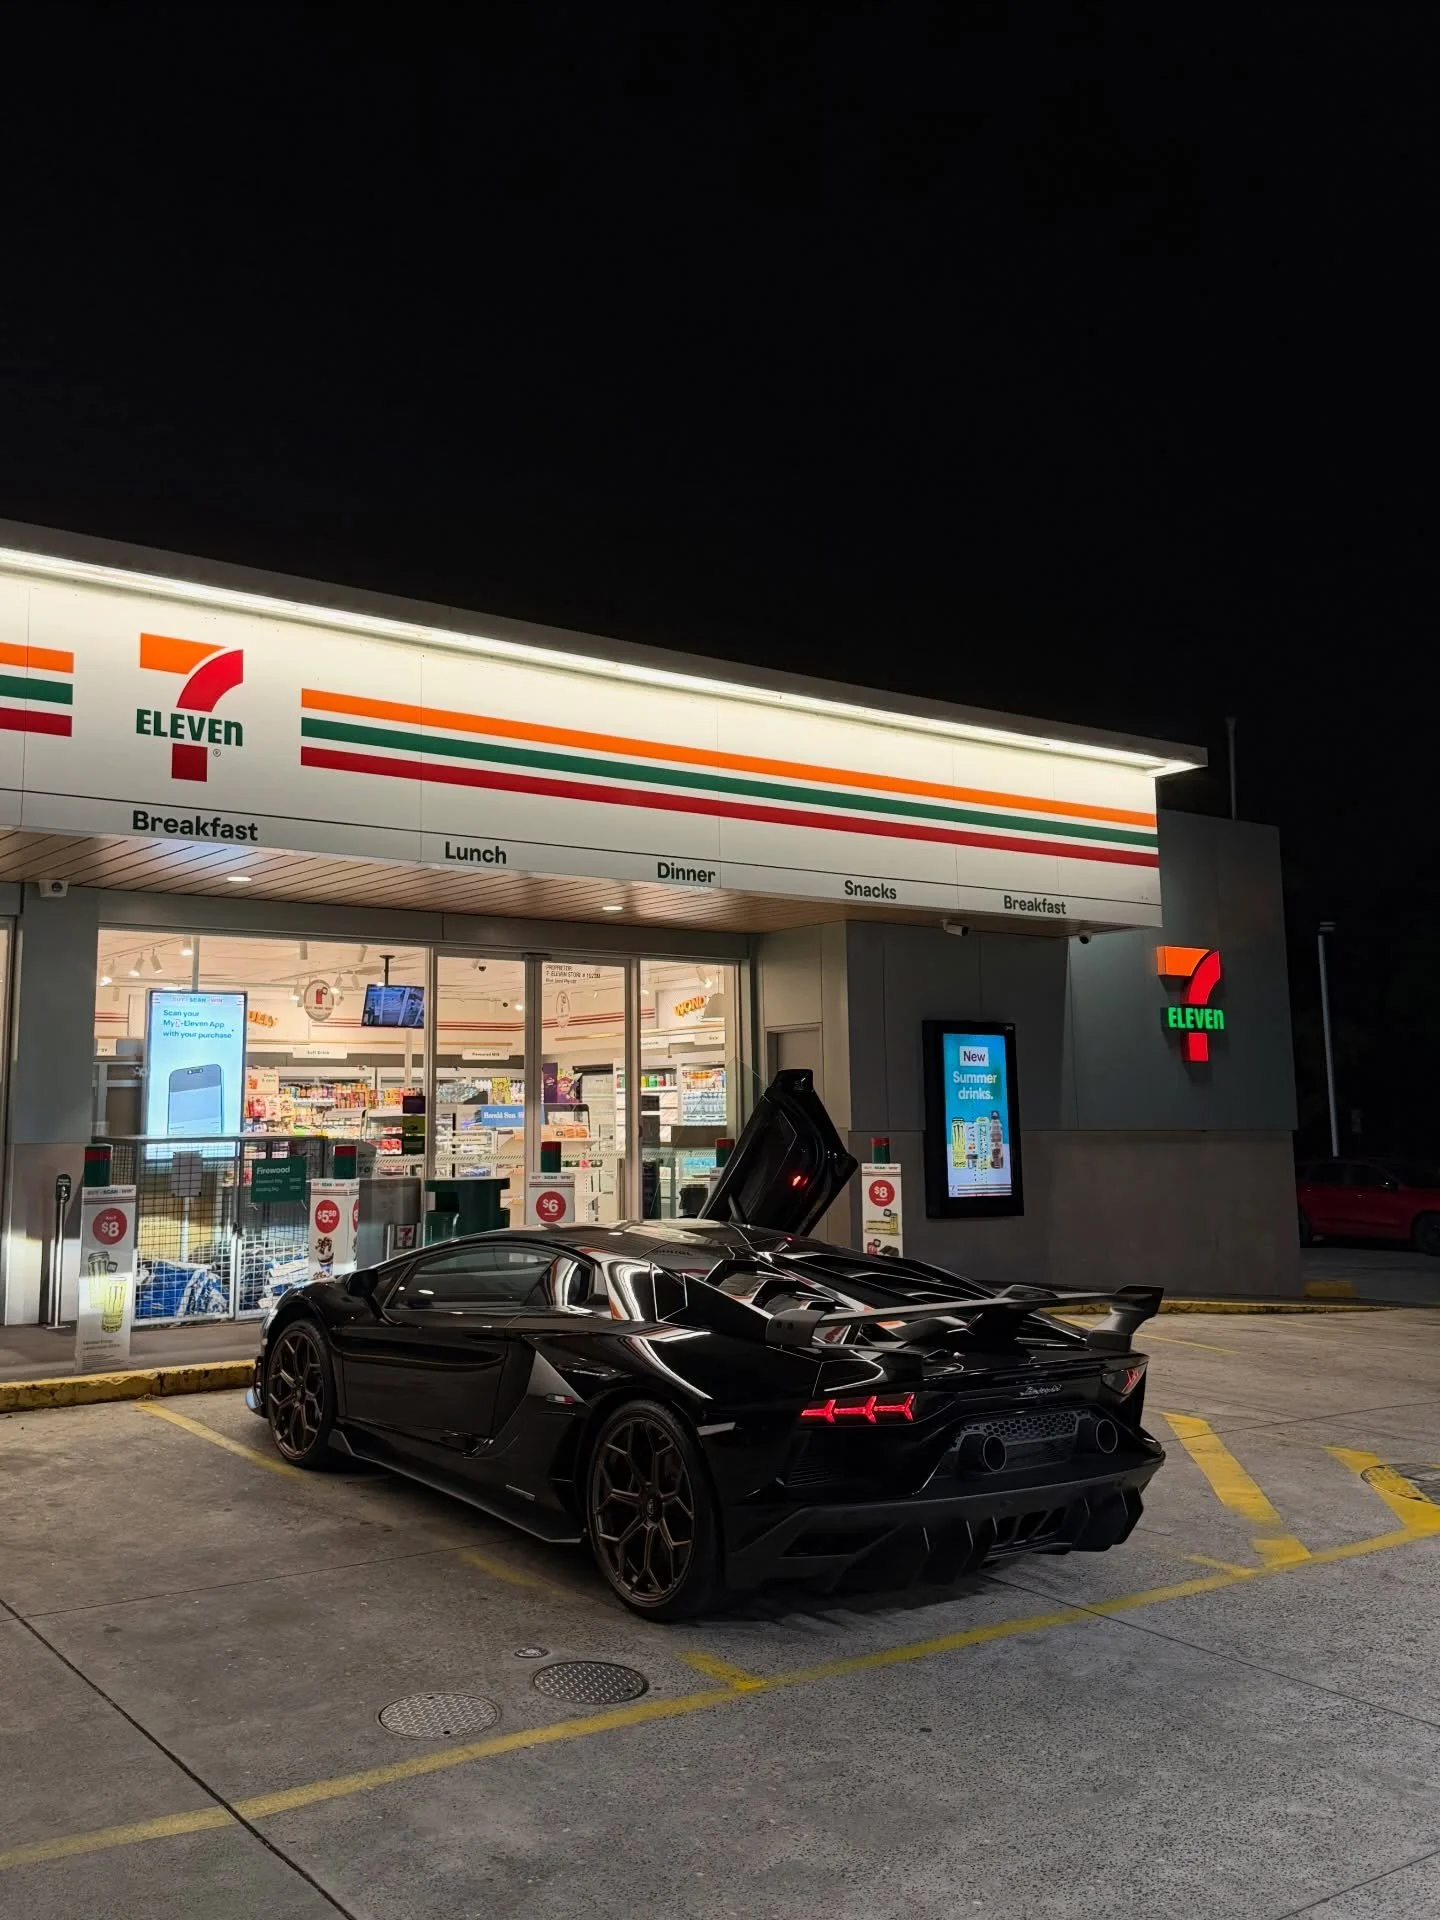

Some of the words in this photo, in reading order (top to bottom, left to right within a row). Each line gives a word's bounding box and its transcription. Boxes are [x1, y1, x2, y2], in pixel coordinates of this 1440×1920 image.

[139, 632, 244, 783] 7
[132, 809, 259, 841] Breakfast
[444, 841, 507, 865] Lunch
[657, 862, 716, 883] Dinner
[844, 879, 898, 900] Snacks
[1003, 895, 1067, 915] Breakfast
[1155, 945, 1221, 1062] 7
[163, 1009, 182, 1017] Scan
[163, 1019, 175, 1028] My
[209, 1021, 225, 1029] App
[963, 1050, 986, 1062] New
[952, 1071, 998, 1084] Summer
[958, 1087, 994, 1100] drinks.
[256, 1166, 291, 1175] Firewood
[873, 1185, 889, 1199] $8
[542, 1198, 560, 1213] $6
[101, 1220, 120, 1237] $8
